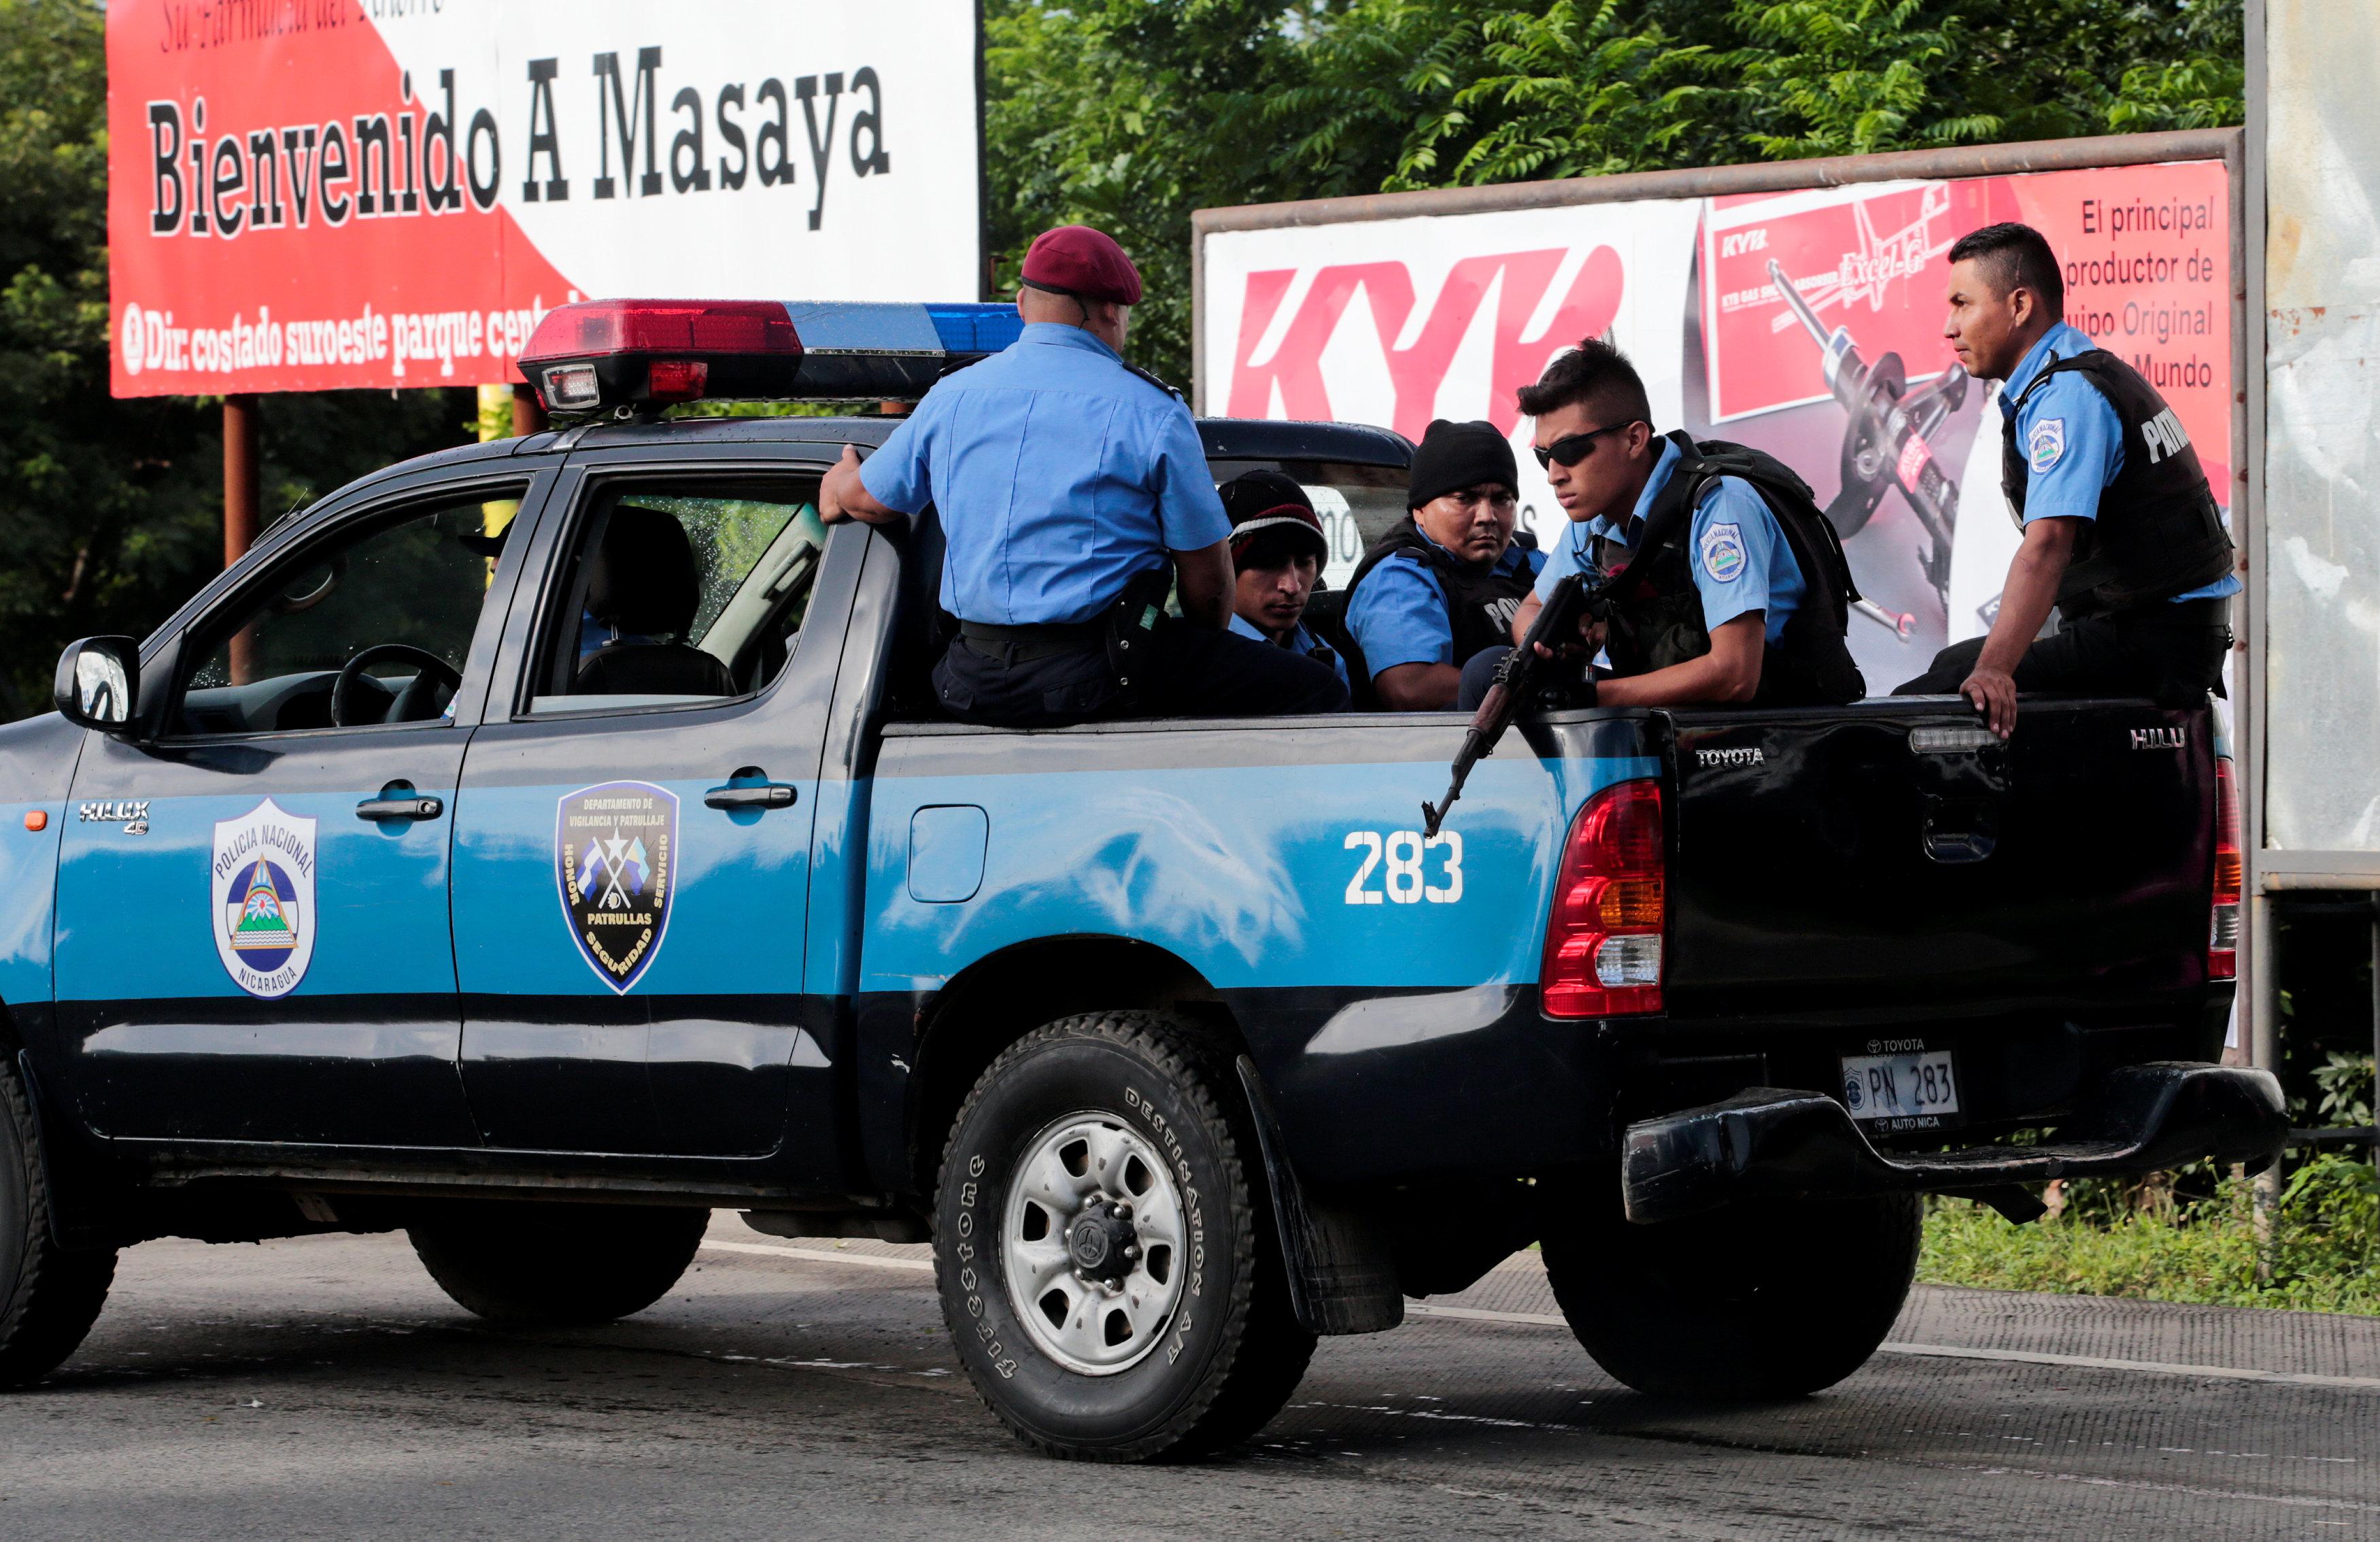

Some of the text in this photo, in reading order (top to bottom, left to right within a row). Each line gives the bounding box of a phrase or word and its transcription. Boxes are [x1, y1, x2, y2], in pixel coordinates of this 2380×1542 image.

[147, 46, 890, 239] Bienvenido A Masaya
[2082, 195, 2213, 241] El principal
[1722, 229, 1768, 258] KYB
[2067, 248, 2213, 296] productor de
[191, 305, 283, 373] costado
[286, 302, 388, 366] suroeste
[391, 310, 483, 377] parque
[2123, 301, 2212, 344] Original
[2135, 354, 2212, 388] Mundo
[1696, 748, 1765, 767] TOYOTA
[2130, 727, 2186, 750] HILU
[80, 801, 150, 822] HILUX
[569, 815, 664, 826] VIGILANCIA Y PATRULLAJE
[583, 798, 653, 810] DEPARTAMENTO DE
[215, 824, 313, 880] POLICIA NACIONAL
[653, 834, 668, 909] SERVICIO
[1344, 830, 1463, 905] 283
[564, 843, 580, 906] HONOR
[588, 913, 652, 925] PATRULLAS
[585, 928, 652, 975] SEGURIDAD
[239, 966, 297, 992] NICARAGUA
[1883, 1038, 1924, 1052] TOYOTA
[1869, 1064, 1950, 1109] PN 283
[1890, 1116, 1940, 1130] AUTO NICA
[1125, 1086, 1206, 1367] DESTINATION A/T
[957, 1154, 1017, 1379] Firestone
